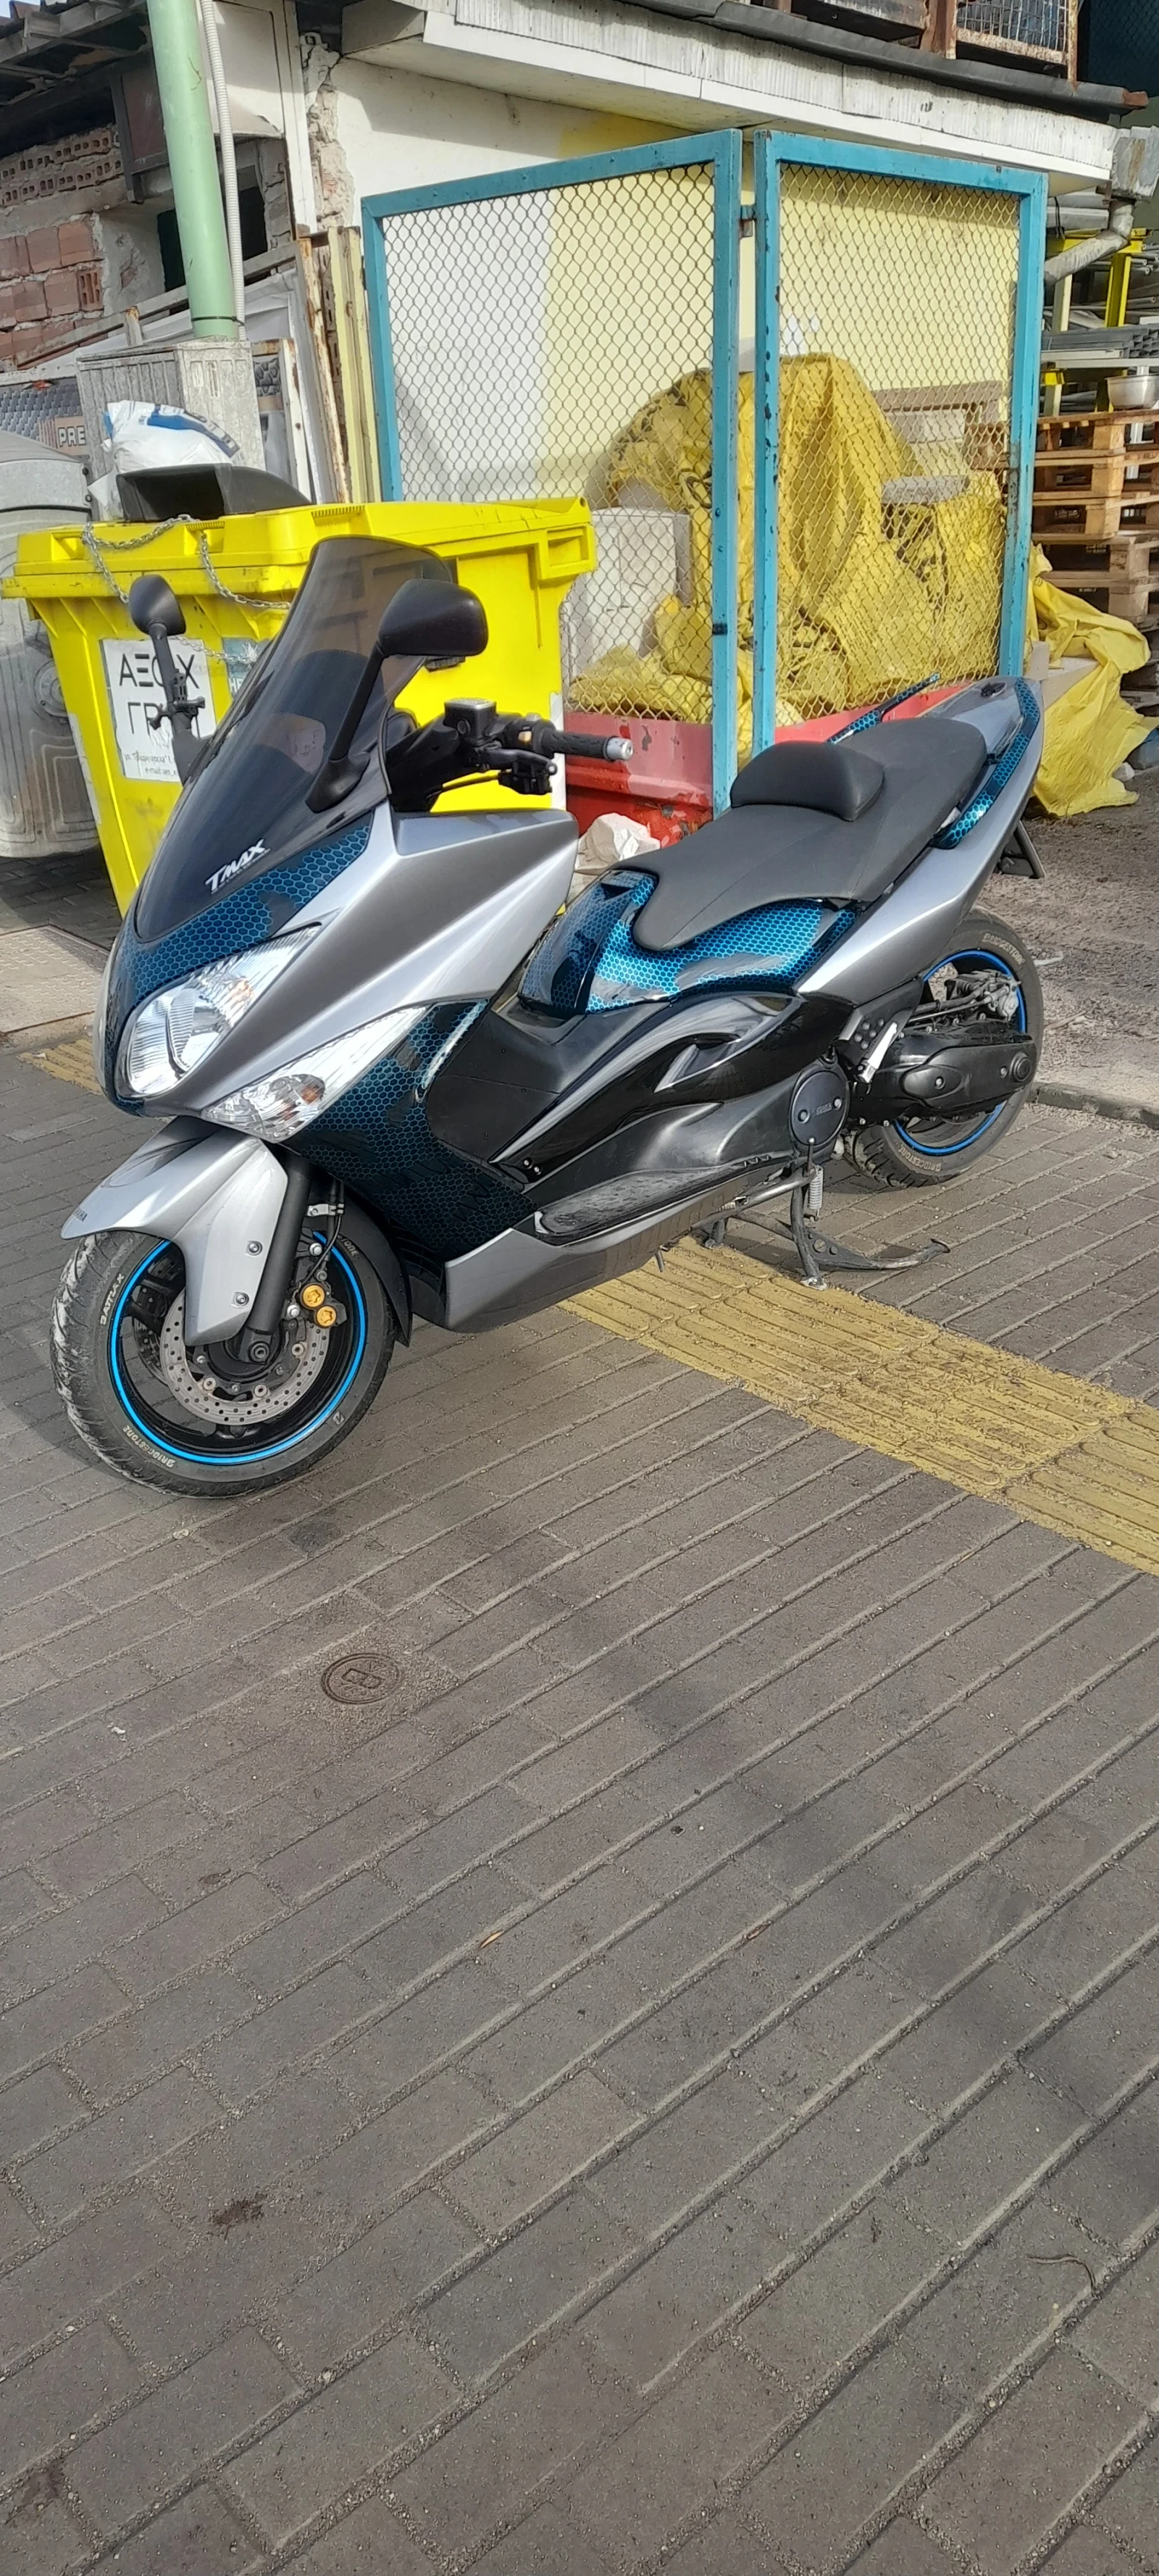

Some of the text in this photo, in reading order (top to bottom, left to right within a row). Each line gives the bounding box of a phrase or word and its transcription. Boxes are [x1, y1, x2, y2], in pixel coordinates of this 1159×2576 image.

[57, 425, 86, 446] PRE
[205, 839, 265, 891] TMAX
[982, 933, 1026, 965] BRIDGESTONE
[898, 1145, 942, 1172] BRIDGESTONE
[122, 1425, 176, 1468] BRIDGESTONE
